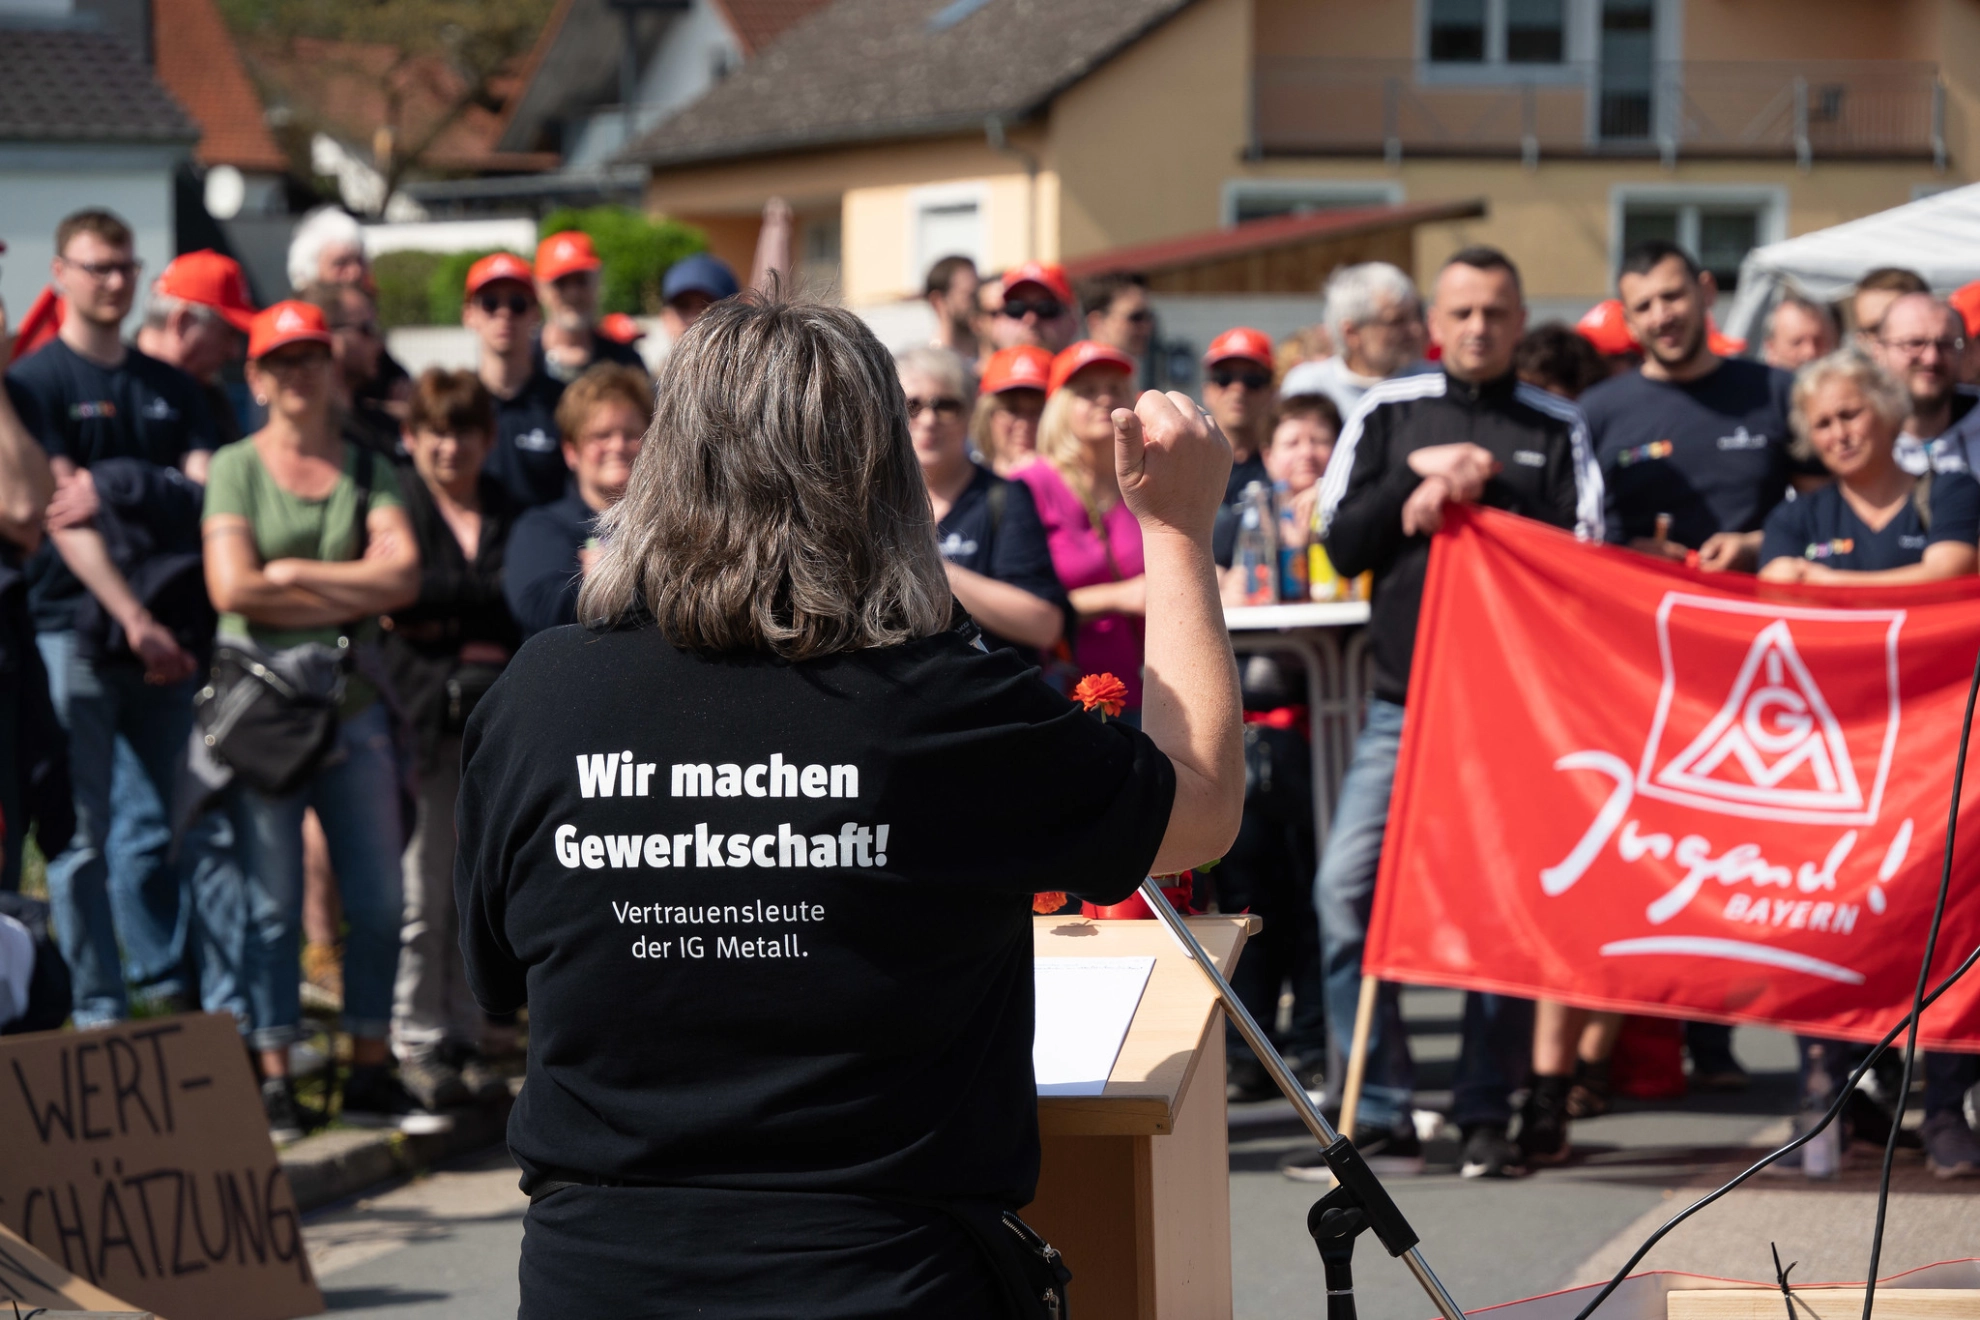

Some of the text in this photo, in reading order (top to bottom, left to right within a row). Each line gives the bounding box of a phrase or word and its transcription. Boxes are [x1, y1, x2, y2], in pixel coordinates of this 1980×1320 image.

[576, 750, 858, 798] Wir machen
[555, 822, 889, 869] Gewerkschaft!
[612, 899, 824, 924] Vertrauensleute
[1723, 892, 1860, 935] BAYERN
[632, 934, 808, 958] der IG Metall.
[11, 1023, 214, 1143] WERT-
[0, 1158, 311, 1286] CHÄTZUNG
